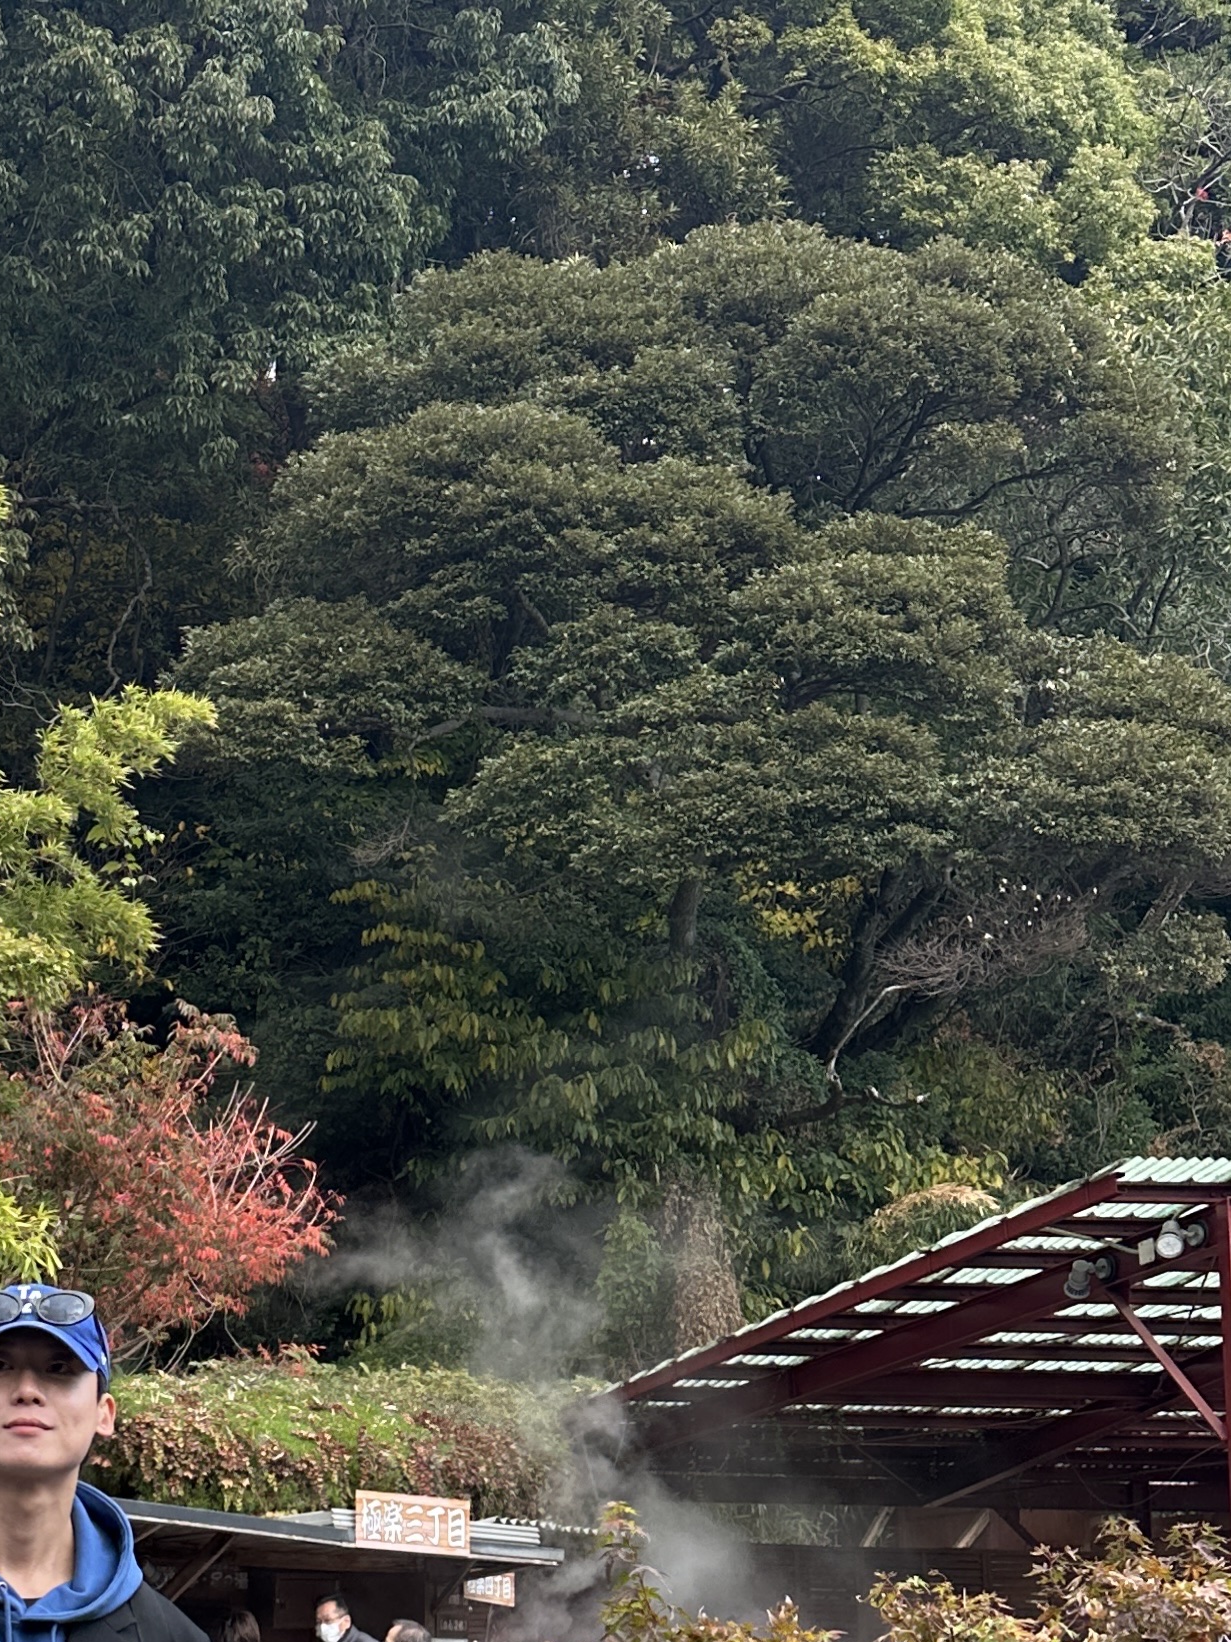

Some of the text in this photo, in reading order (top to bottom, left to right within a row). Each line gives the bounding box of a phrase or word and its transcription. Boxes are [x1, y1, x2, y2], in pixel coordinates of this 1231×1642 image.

[361, 1498, 466, 1548] 極楽三丁目
